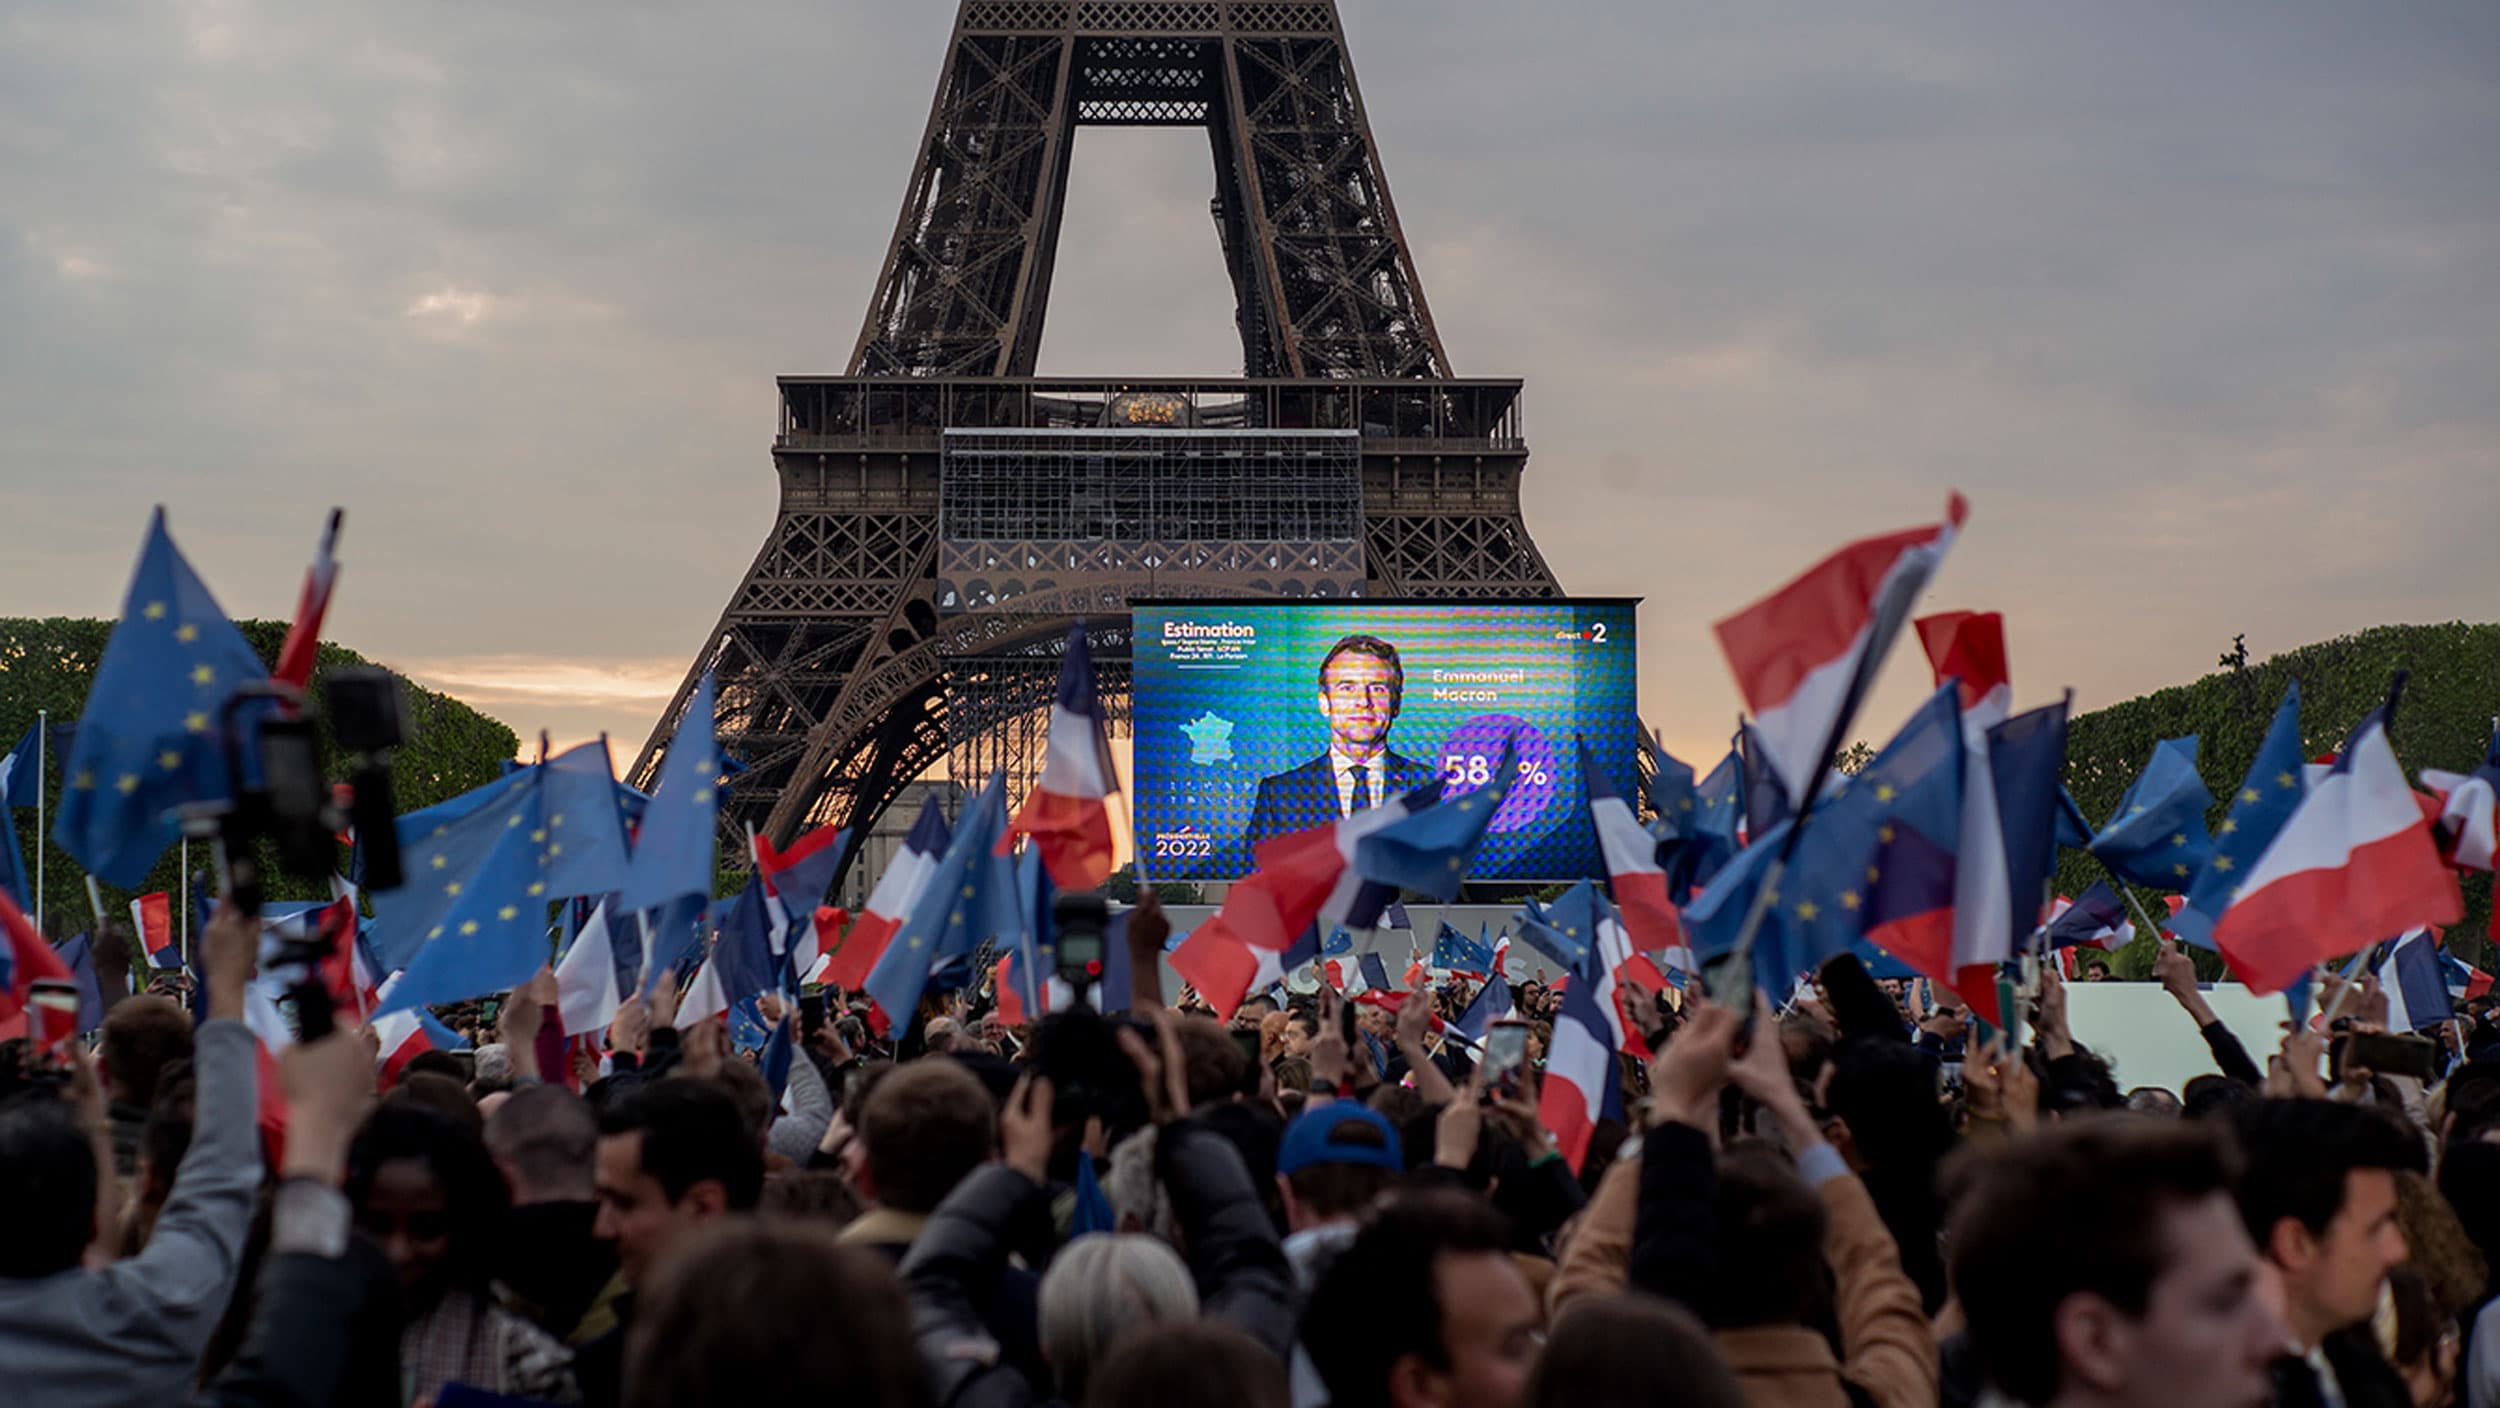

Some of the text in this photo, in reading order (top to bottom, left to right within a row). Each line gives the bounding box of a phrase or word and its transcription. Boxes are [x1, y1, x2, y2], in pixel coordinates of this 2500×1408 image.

[1164, 621, 1254, 637] Estimation
[1592, 623, 1606, 643] 2
[1433, 669, 1524, 683] Emmanuel
[1433, 688, 1497, 701] Macron
[1156, 840, 1211, 857] 2022
